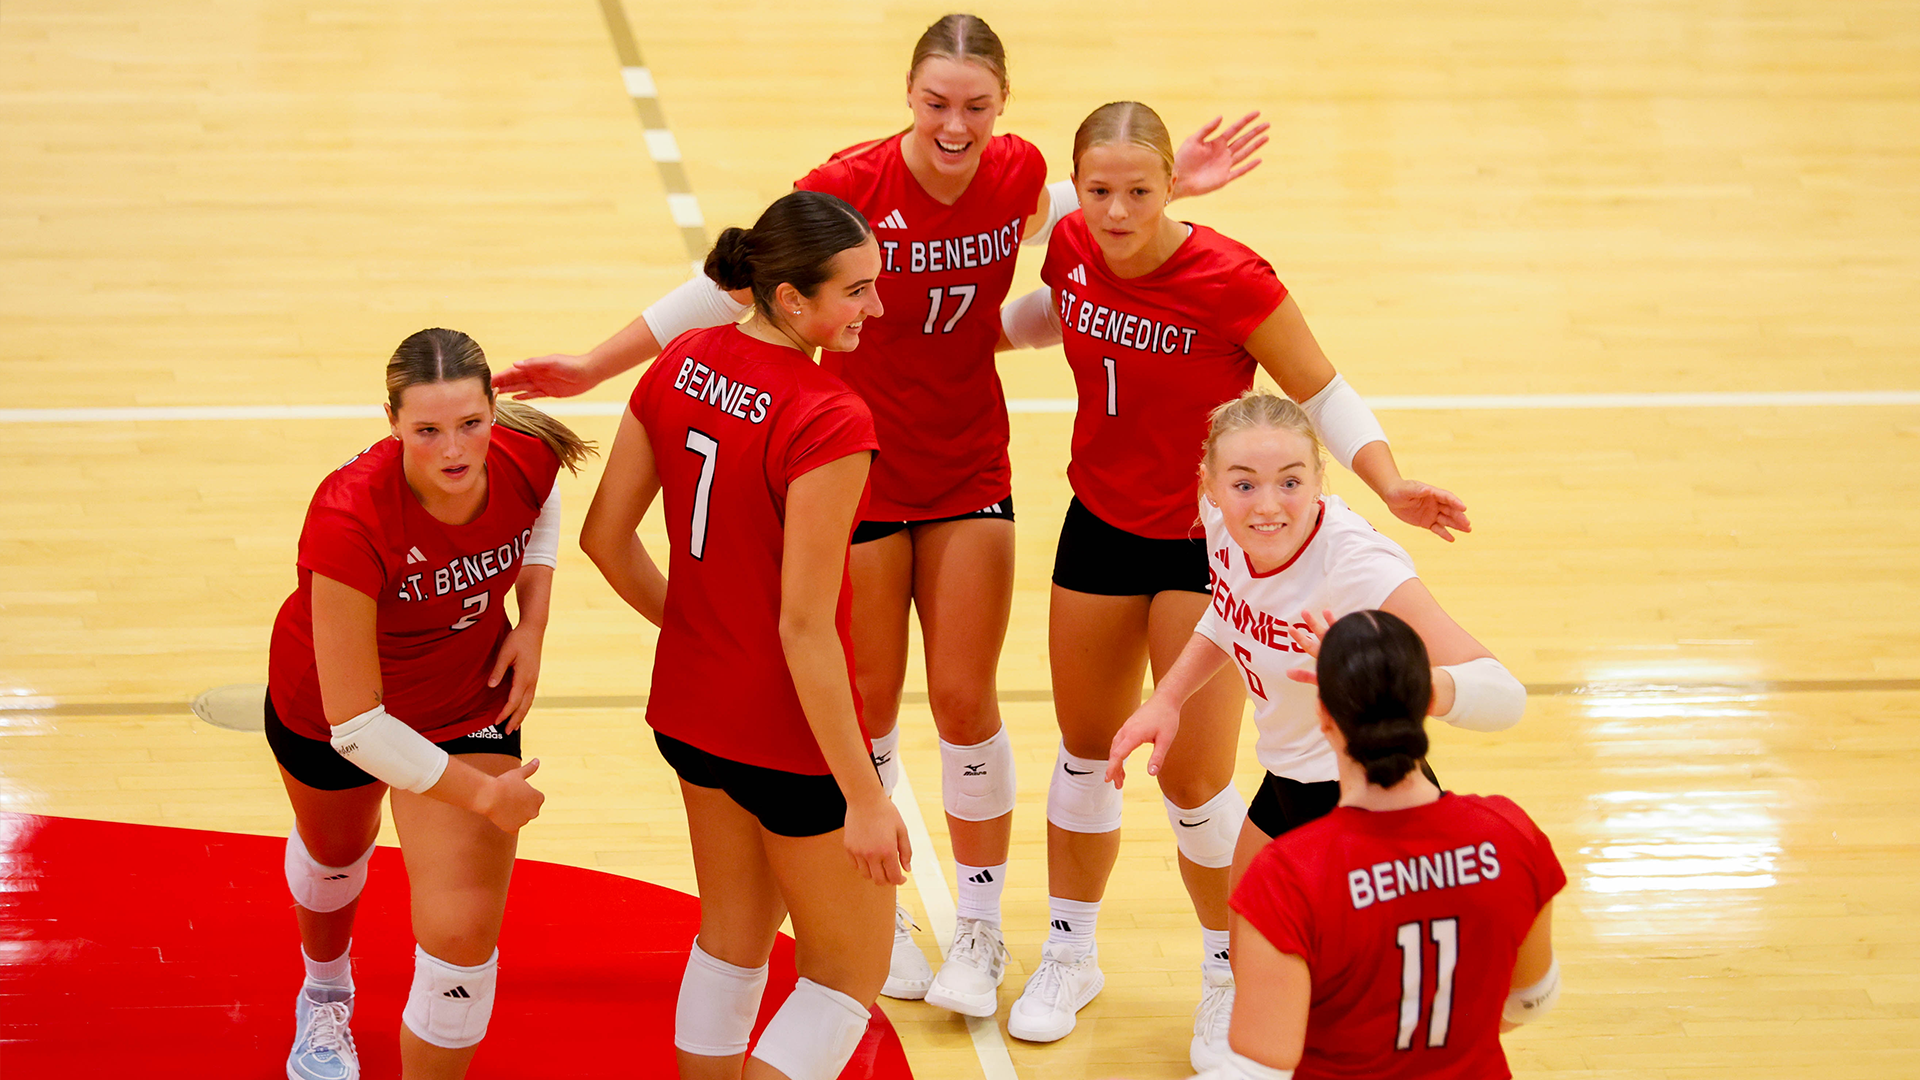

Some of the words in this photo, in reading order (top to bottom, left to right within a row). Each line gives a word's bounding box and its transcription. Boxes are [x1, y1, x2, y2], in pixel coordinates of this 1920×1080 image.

[879, 239, 902, 273] T.
[909, 216, 1022, 273] BENEDICT
[922, 284, 977, 335] 17
[1076, 300, 1199, 356] BENEDICT
[673, 356, 772, 424] BENNIES
[1103, 357, 1118, 417] 1
[684, 426, 719, 562] 7
[434, 527, 531, 597] BENEDIC
[449, 589, 490, 631] 2
[1233, 641, 1269, 702] 6
[1348, 840, 1501, 910] BENNIES
[1395, 915, 1460, 1051] 11
